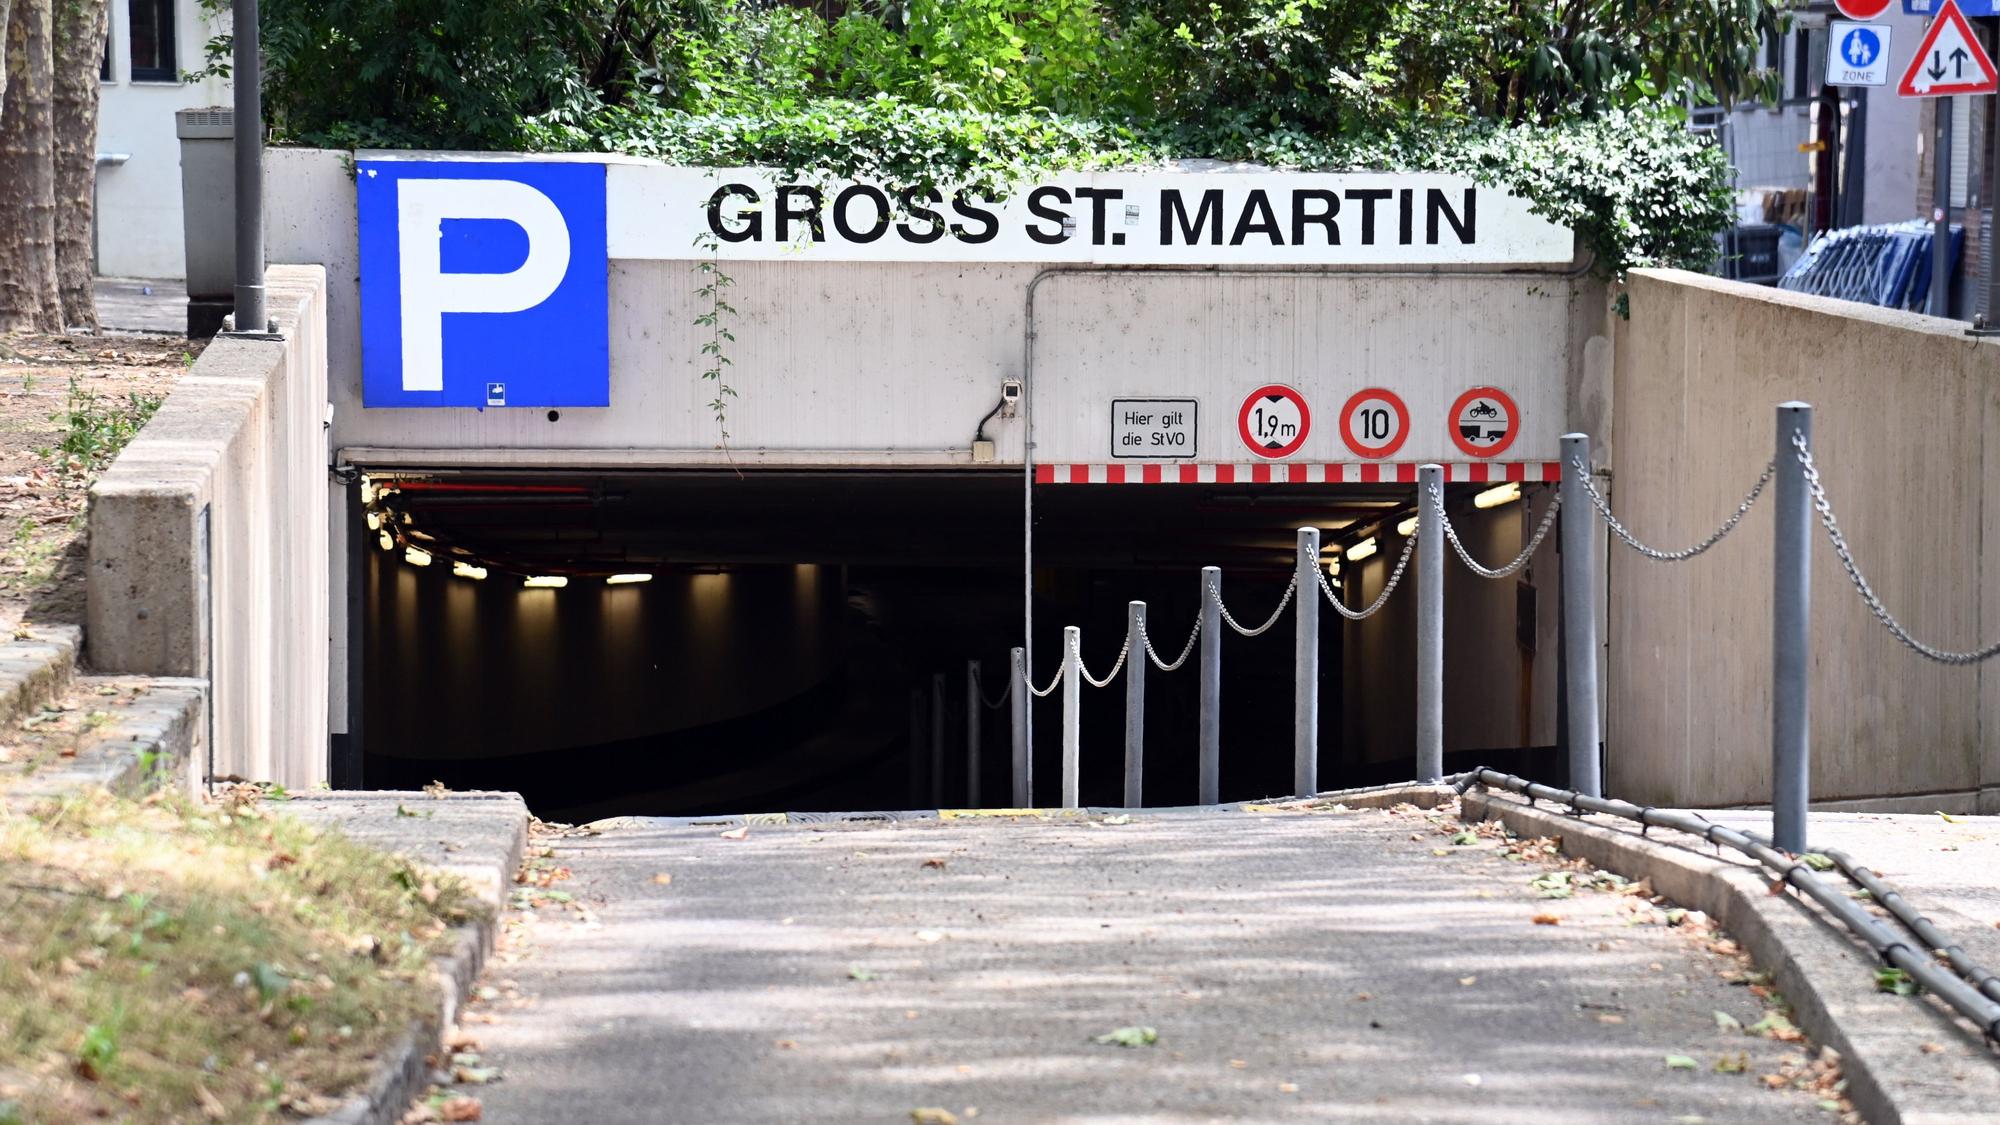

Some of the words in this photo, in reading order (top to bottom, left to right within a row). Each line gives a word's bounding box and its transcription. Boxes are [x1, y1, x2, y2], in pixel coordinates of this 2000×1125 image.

[1842, 70, 1874, 82] ZONE
[706, 183, 1000, 244] GROSS
[1025, 185, 1126, 246] ST.
[1160, 187, 1477, 247] MARTIN
[397, 178, 571, 391] P
[1124, 411, 1154, 425] Hier
[1162, 411, 1183, 429] gilt
[1360, 409, 1389, 440] 10
[1122, 431, 1143, 446] die
[1150, 431, 1185, 446] StVO
